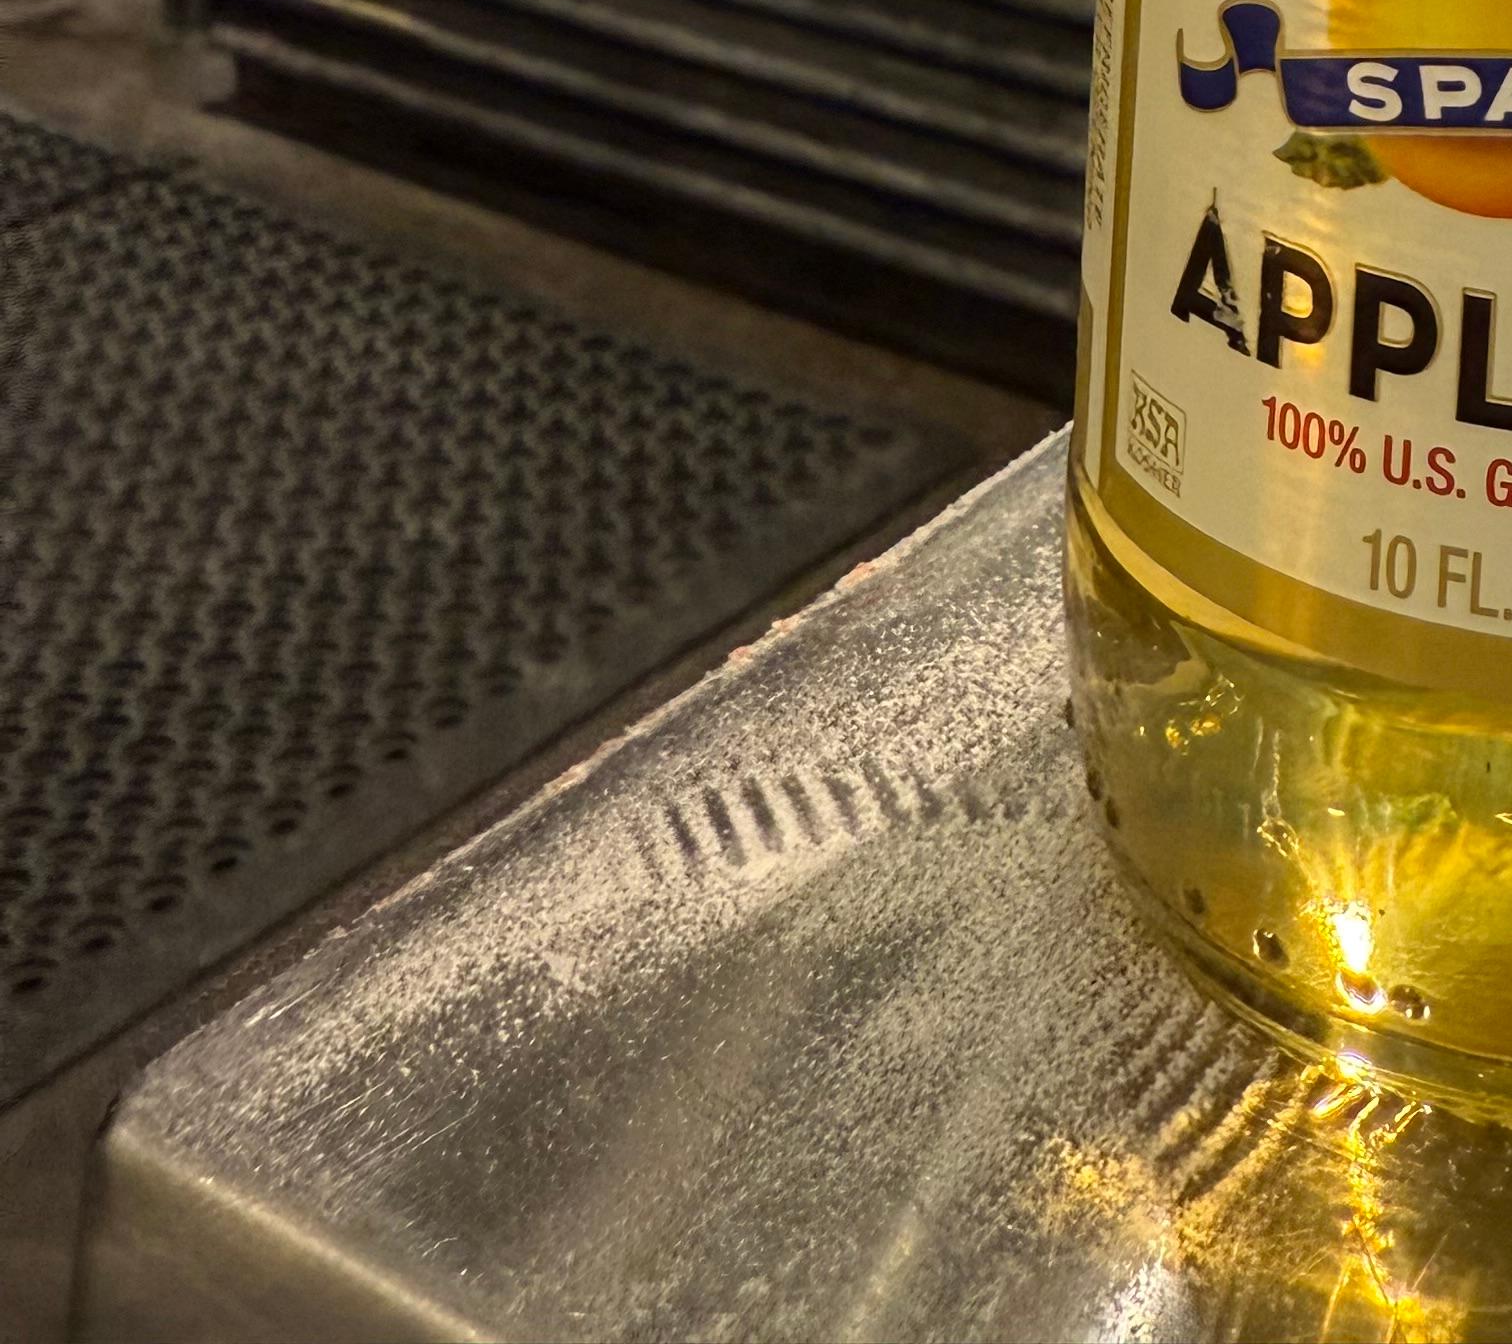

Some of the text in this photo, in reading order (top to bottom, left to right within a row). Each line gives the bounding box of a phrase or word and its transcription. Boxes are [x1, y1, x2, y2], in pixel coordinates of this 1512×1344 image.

[1262, 396, 1366, 474] 100%
[1383, 434, 1466, 499] U.S.
[1363, 527, 1417, 600] 10
[1438, 543, 1512, 623] FL.
